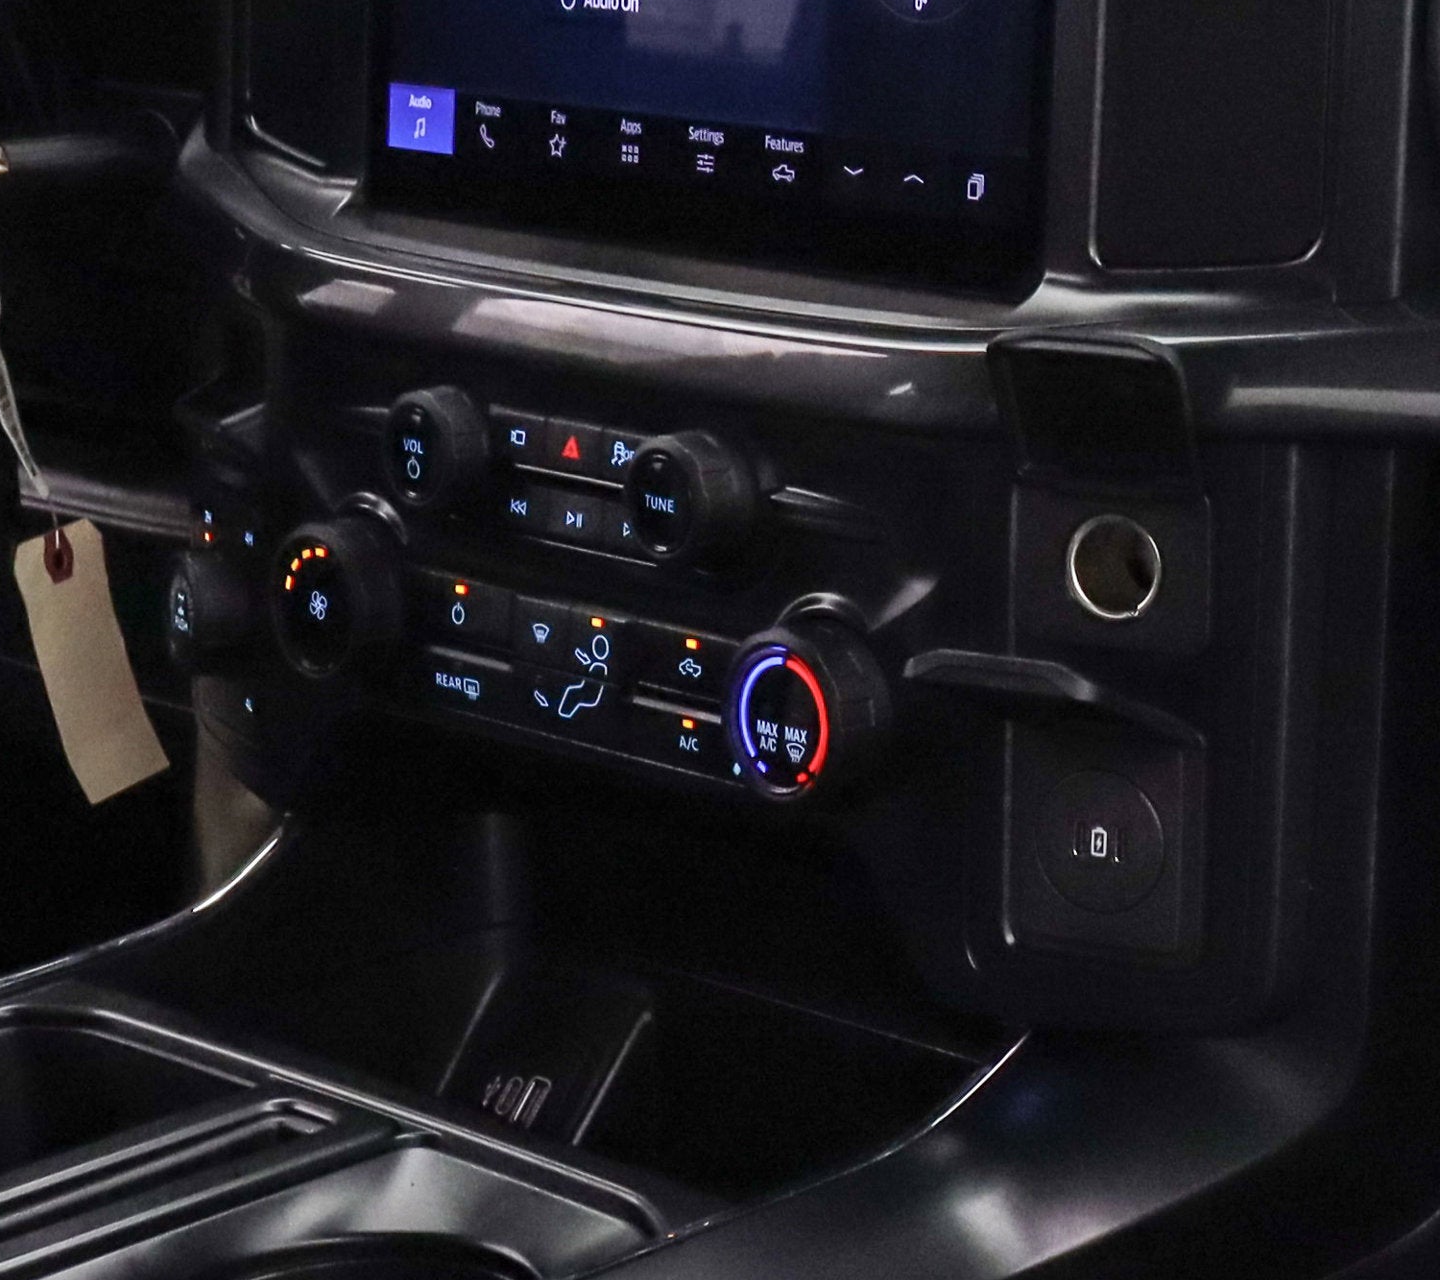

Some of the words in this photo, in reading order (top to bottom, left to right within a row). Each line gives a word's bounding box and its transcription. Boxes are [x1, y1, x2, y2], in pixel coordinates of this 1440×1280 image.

[408, 94, 432, 110] Audio
[475, 101, 501, 118] Phone
[550, 110, 567, 125] Fav
[620, 118, 642, 135] Apps
[688, 126, 725, 146] Settings
[765, 135, 804, 153] Features
[403, 438, 424, 455] VOL
[644, 494, 675, 513] TUNE
[435, 672, 463, 692] REAR
[756, 719, 778, 738] MAX
[784, 726, 808, 745] MAX
[679, 735, 699, 752] A/C
[759, 736, 777, 753] A/C
